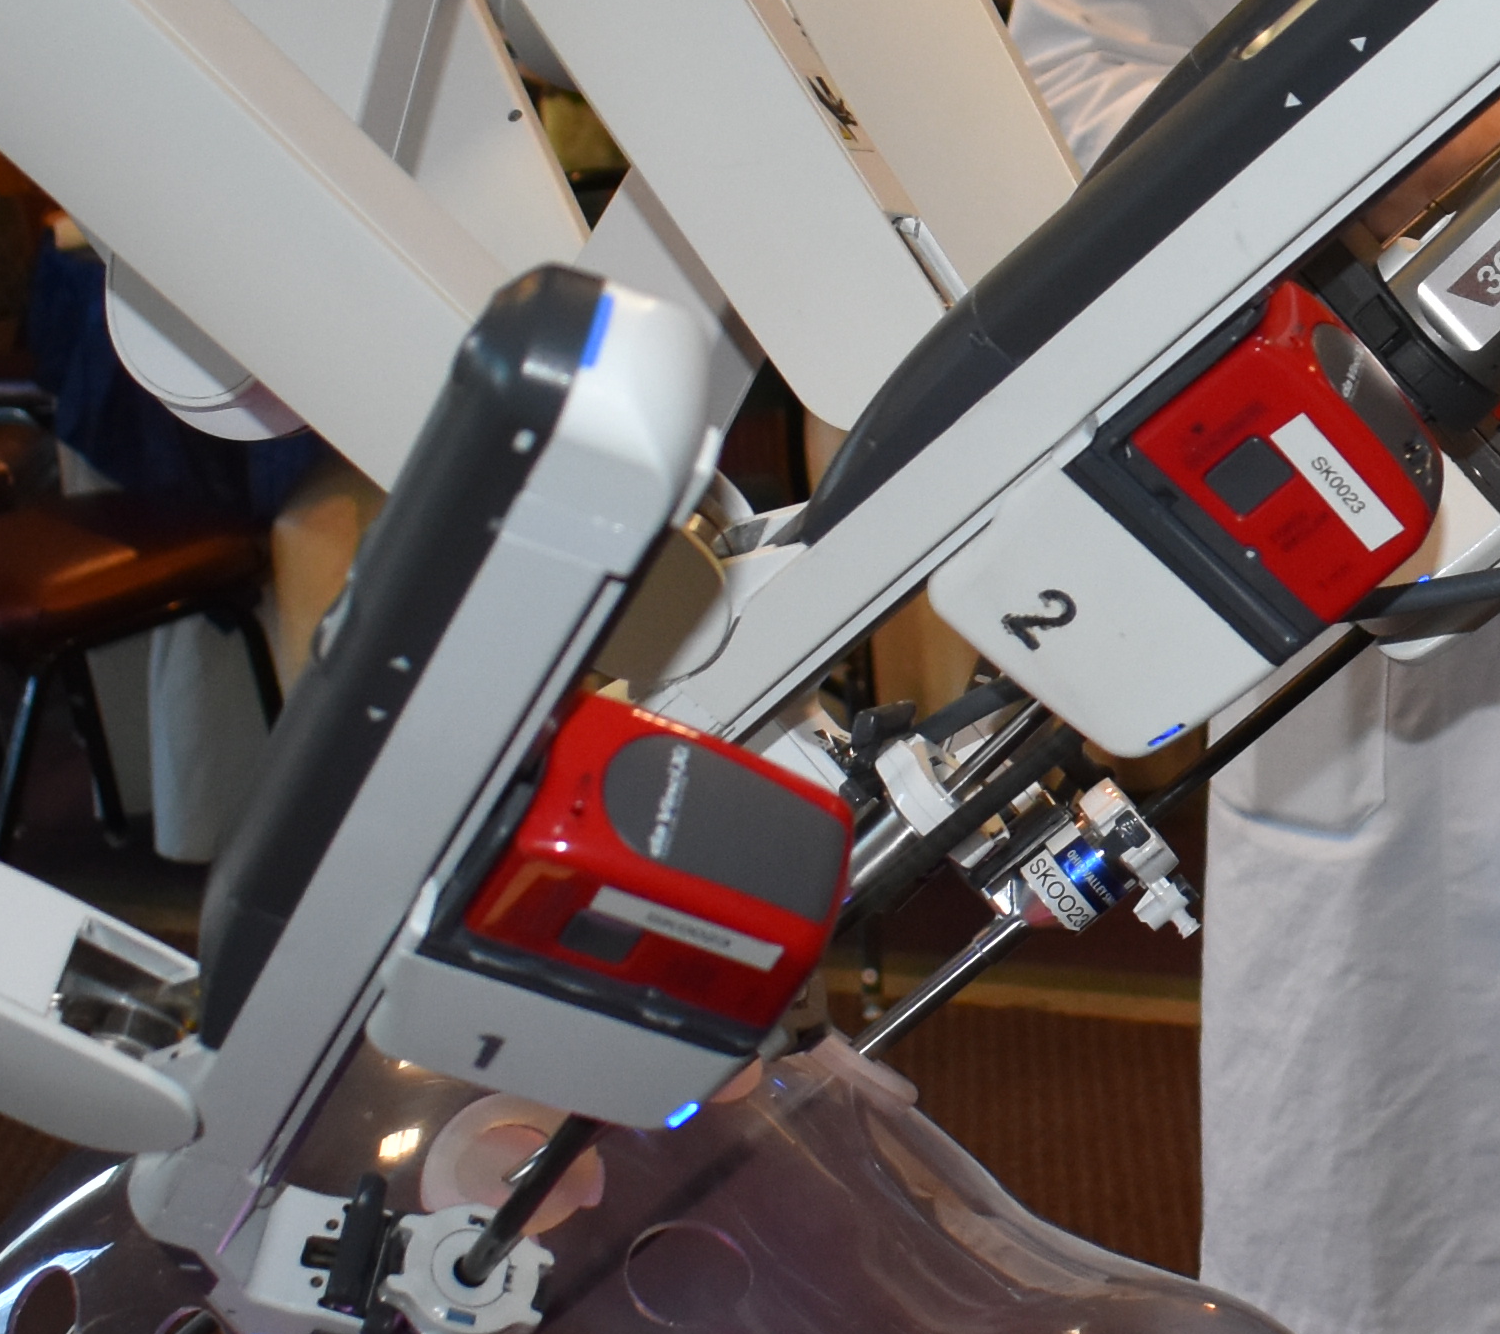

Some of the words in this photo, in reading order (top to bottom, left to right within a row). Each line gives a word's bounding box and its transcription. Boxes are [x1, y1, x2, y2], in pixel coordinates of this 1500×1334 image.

[1310, 455, 1366, 516] SK0023
[1002, 588, 1077, 652] 2
[473, 1033, 506, 1071] 1
